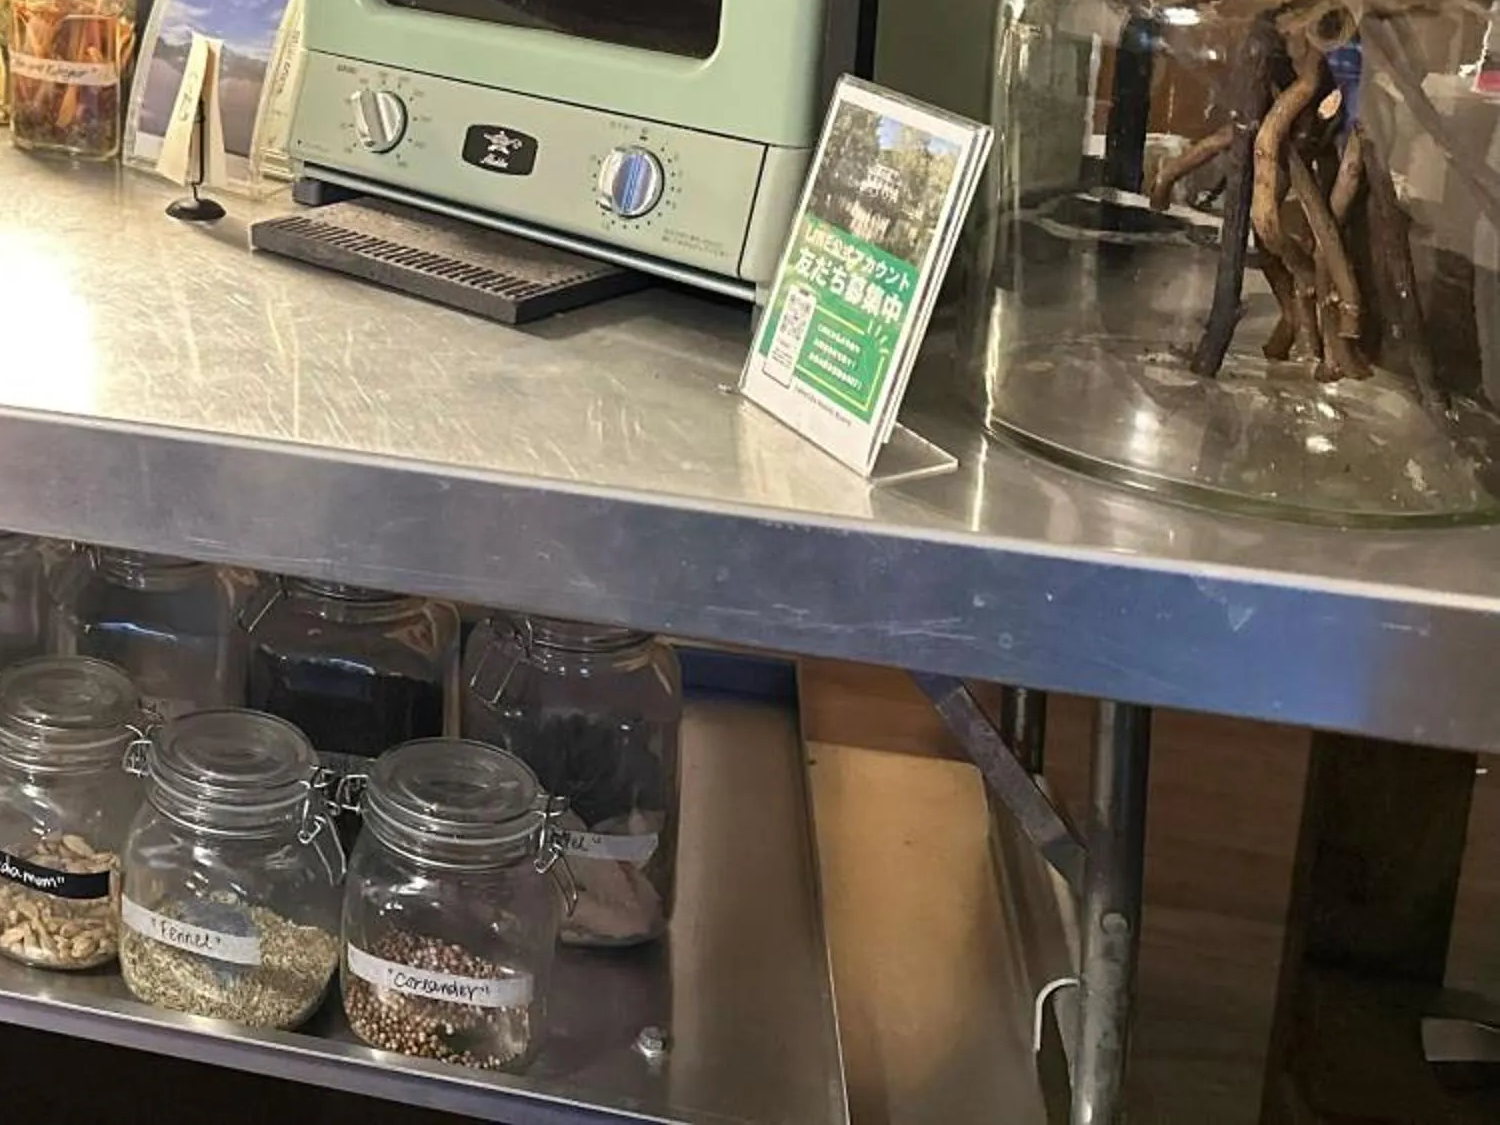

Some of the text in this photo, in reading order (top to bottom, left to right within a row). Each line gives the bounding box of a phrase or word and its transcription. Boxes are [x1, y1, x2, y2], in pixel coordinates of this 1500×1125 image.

[797, 246, 904, 325] 友だち募集中
